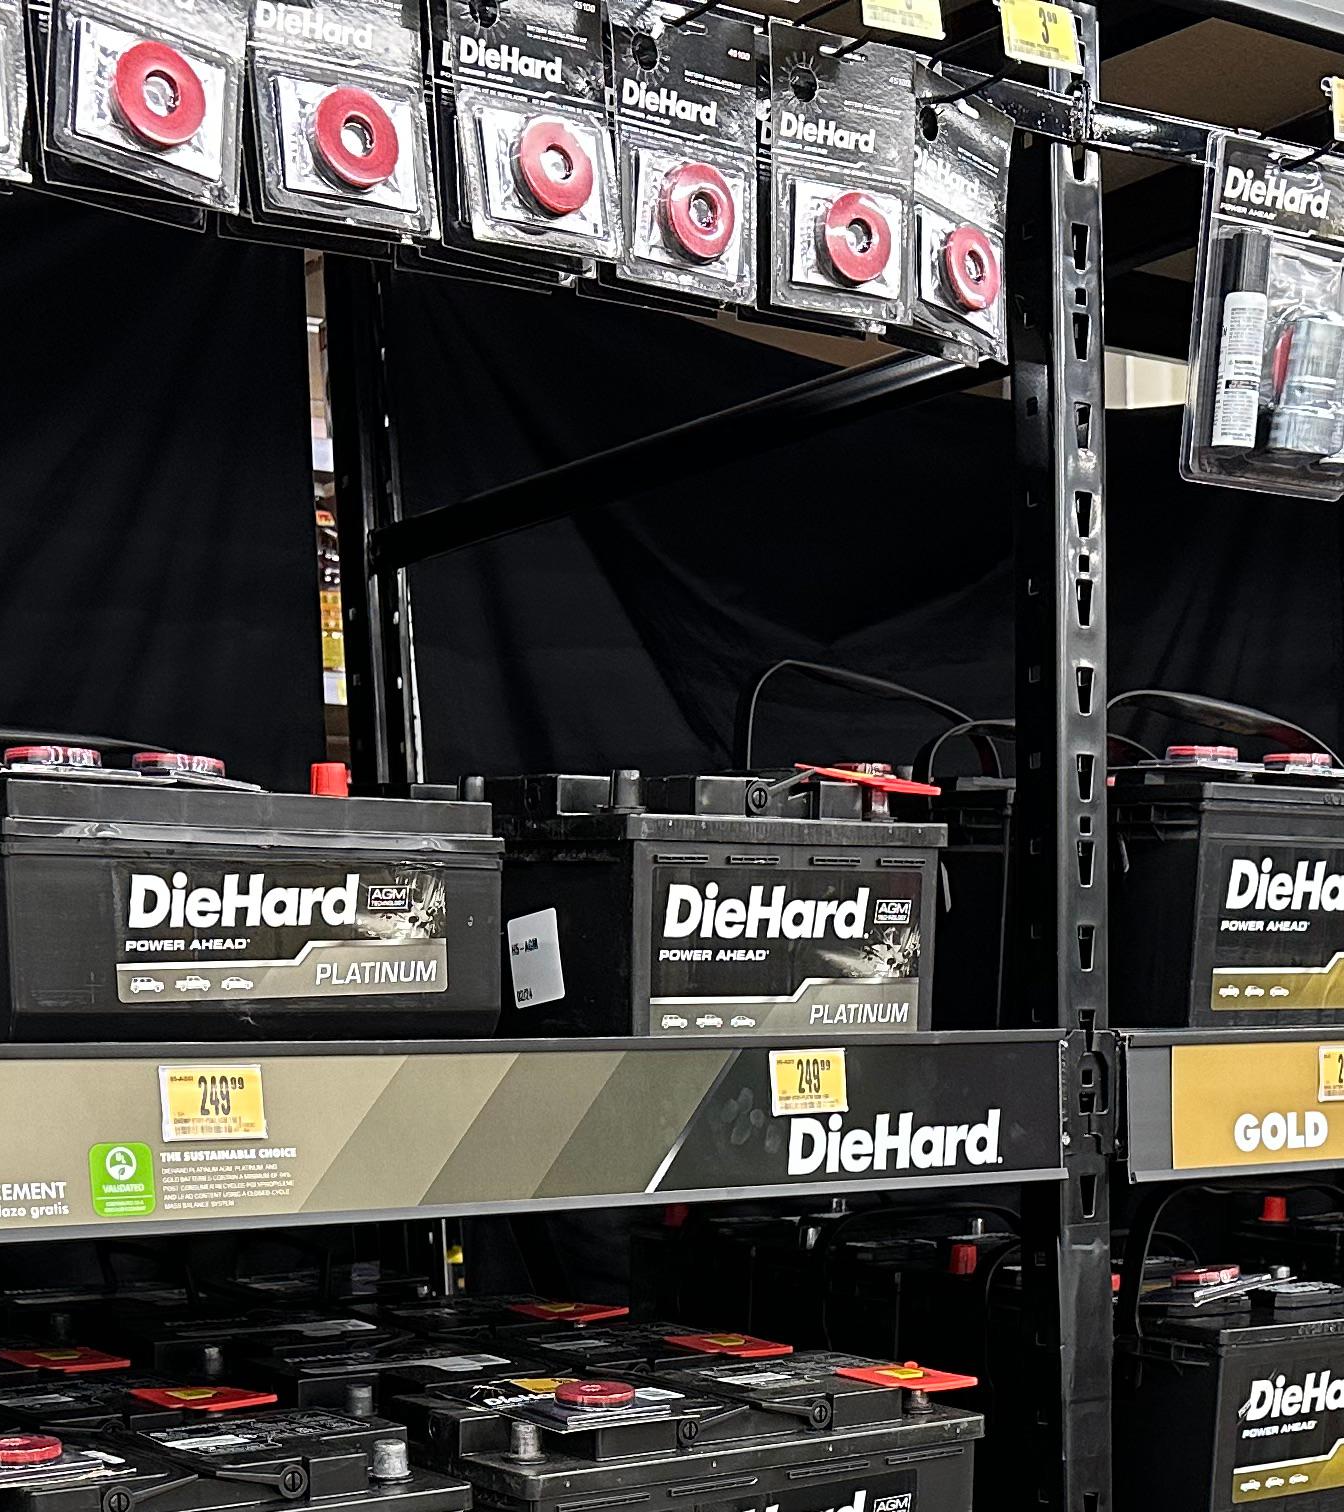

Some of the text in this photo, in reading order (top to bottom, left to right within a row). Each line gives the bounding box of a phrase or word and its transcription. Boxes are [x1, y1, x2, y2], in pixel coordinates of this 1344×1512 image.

[460, 35, 563, 83] DieHard
[622, 78, 717, 127] DieHard
[780, 112, 876, 154] DieHard
[1223, 167, 1330, 218] DieHard
[128, 871, 357, 930] DieHard
[663, 882, 868, 940] DieHard
[315, 959, 437, 987] PLATINUM
[659, 949, 766, 962] POWER AHEAD
[809, 1003, 909, 1026] PLATINUM
[788, 1110, 1001, 1176] DieHard
[1234, 1111, 1328, 1152] GOLD
[161, 1148, 296, 1162] THE SUSTAINABLE CHOICE
[103, 1184, 144, 1193] VALIDATED
[31, 1204, 69, 1221] gratis
